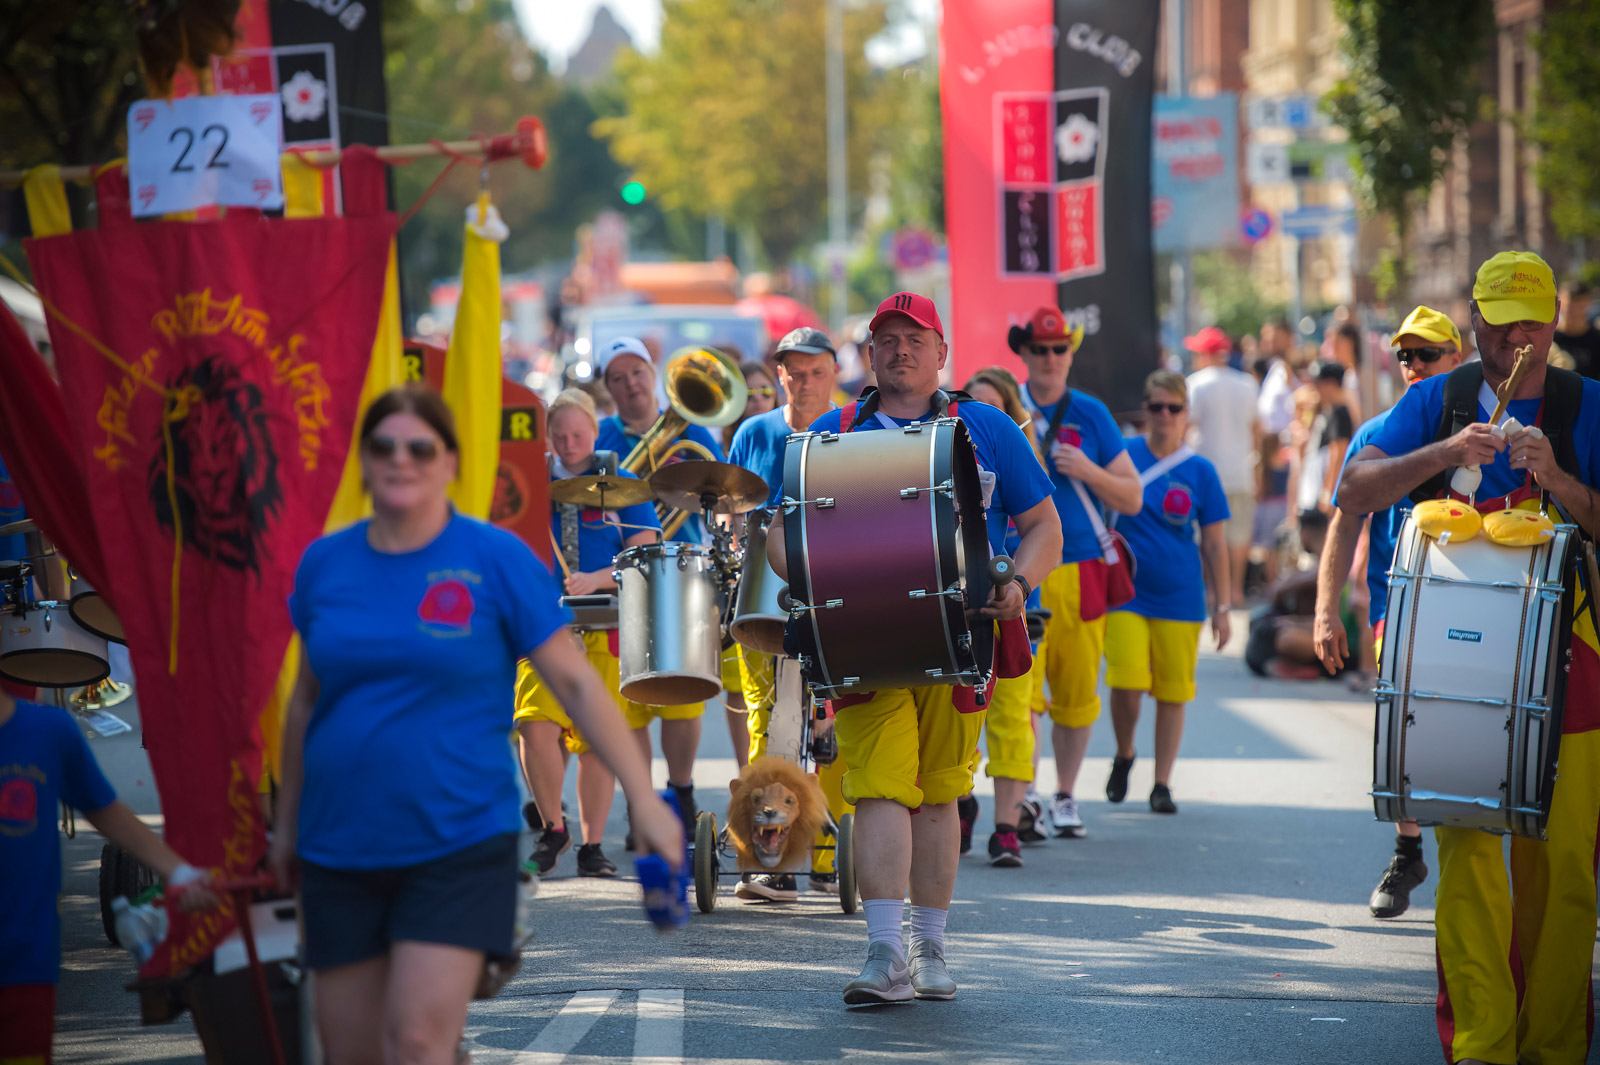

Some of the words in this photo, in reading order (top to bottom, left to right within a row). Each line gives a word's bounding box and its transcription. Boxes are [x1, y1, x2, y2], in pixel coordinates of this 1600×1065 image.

[1066, 22, 1143, 78] CLUB
[168, 123, 230, 173] 22
[510, 411, 532, 439] R
[1449, 630, 1480, 640] Hayman
